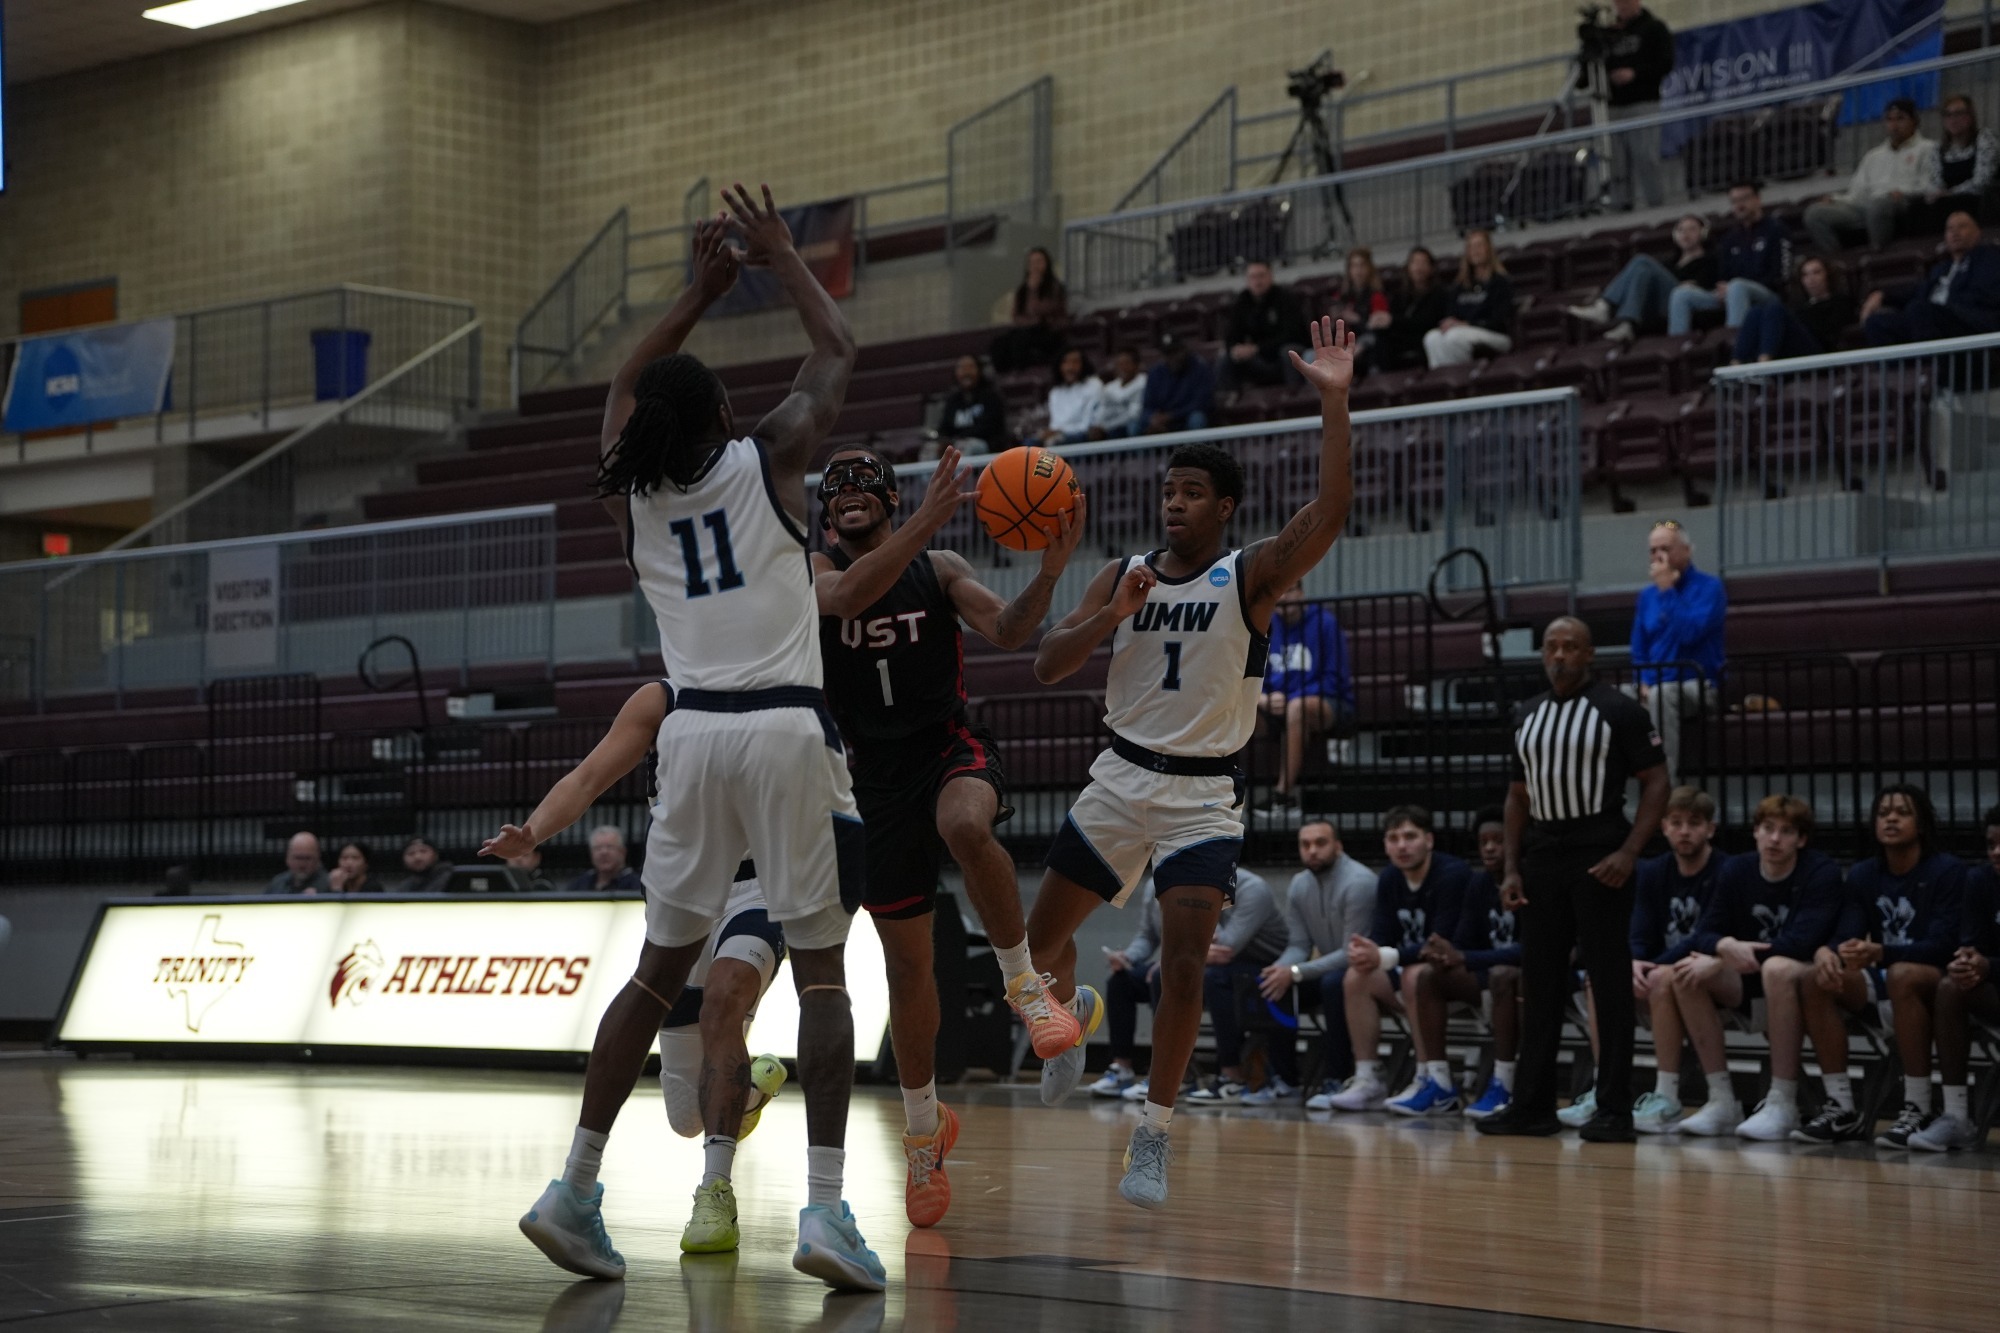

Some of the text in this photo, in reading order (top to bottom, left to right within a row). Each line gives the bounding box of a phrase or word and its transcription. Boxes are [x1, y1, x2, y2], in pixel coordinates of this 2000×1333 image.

[1788, 40, 1812, 71] III
[668, 506, 746, 599] 11
[214, 578, 273, 602] VISITOR
[213, 608, 274, 634] SECTION
[840, 609, 928, 651] UST
[1132, 602, 1220, 632] UMW
[876, 658, 894, 707] 1
[1162, 641, 1182, 691] 1
[153, 956, 254, 983] TRINITY
[381, 955, 591, 996] ATHLETICS
